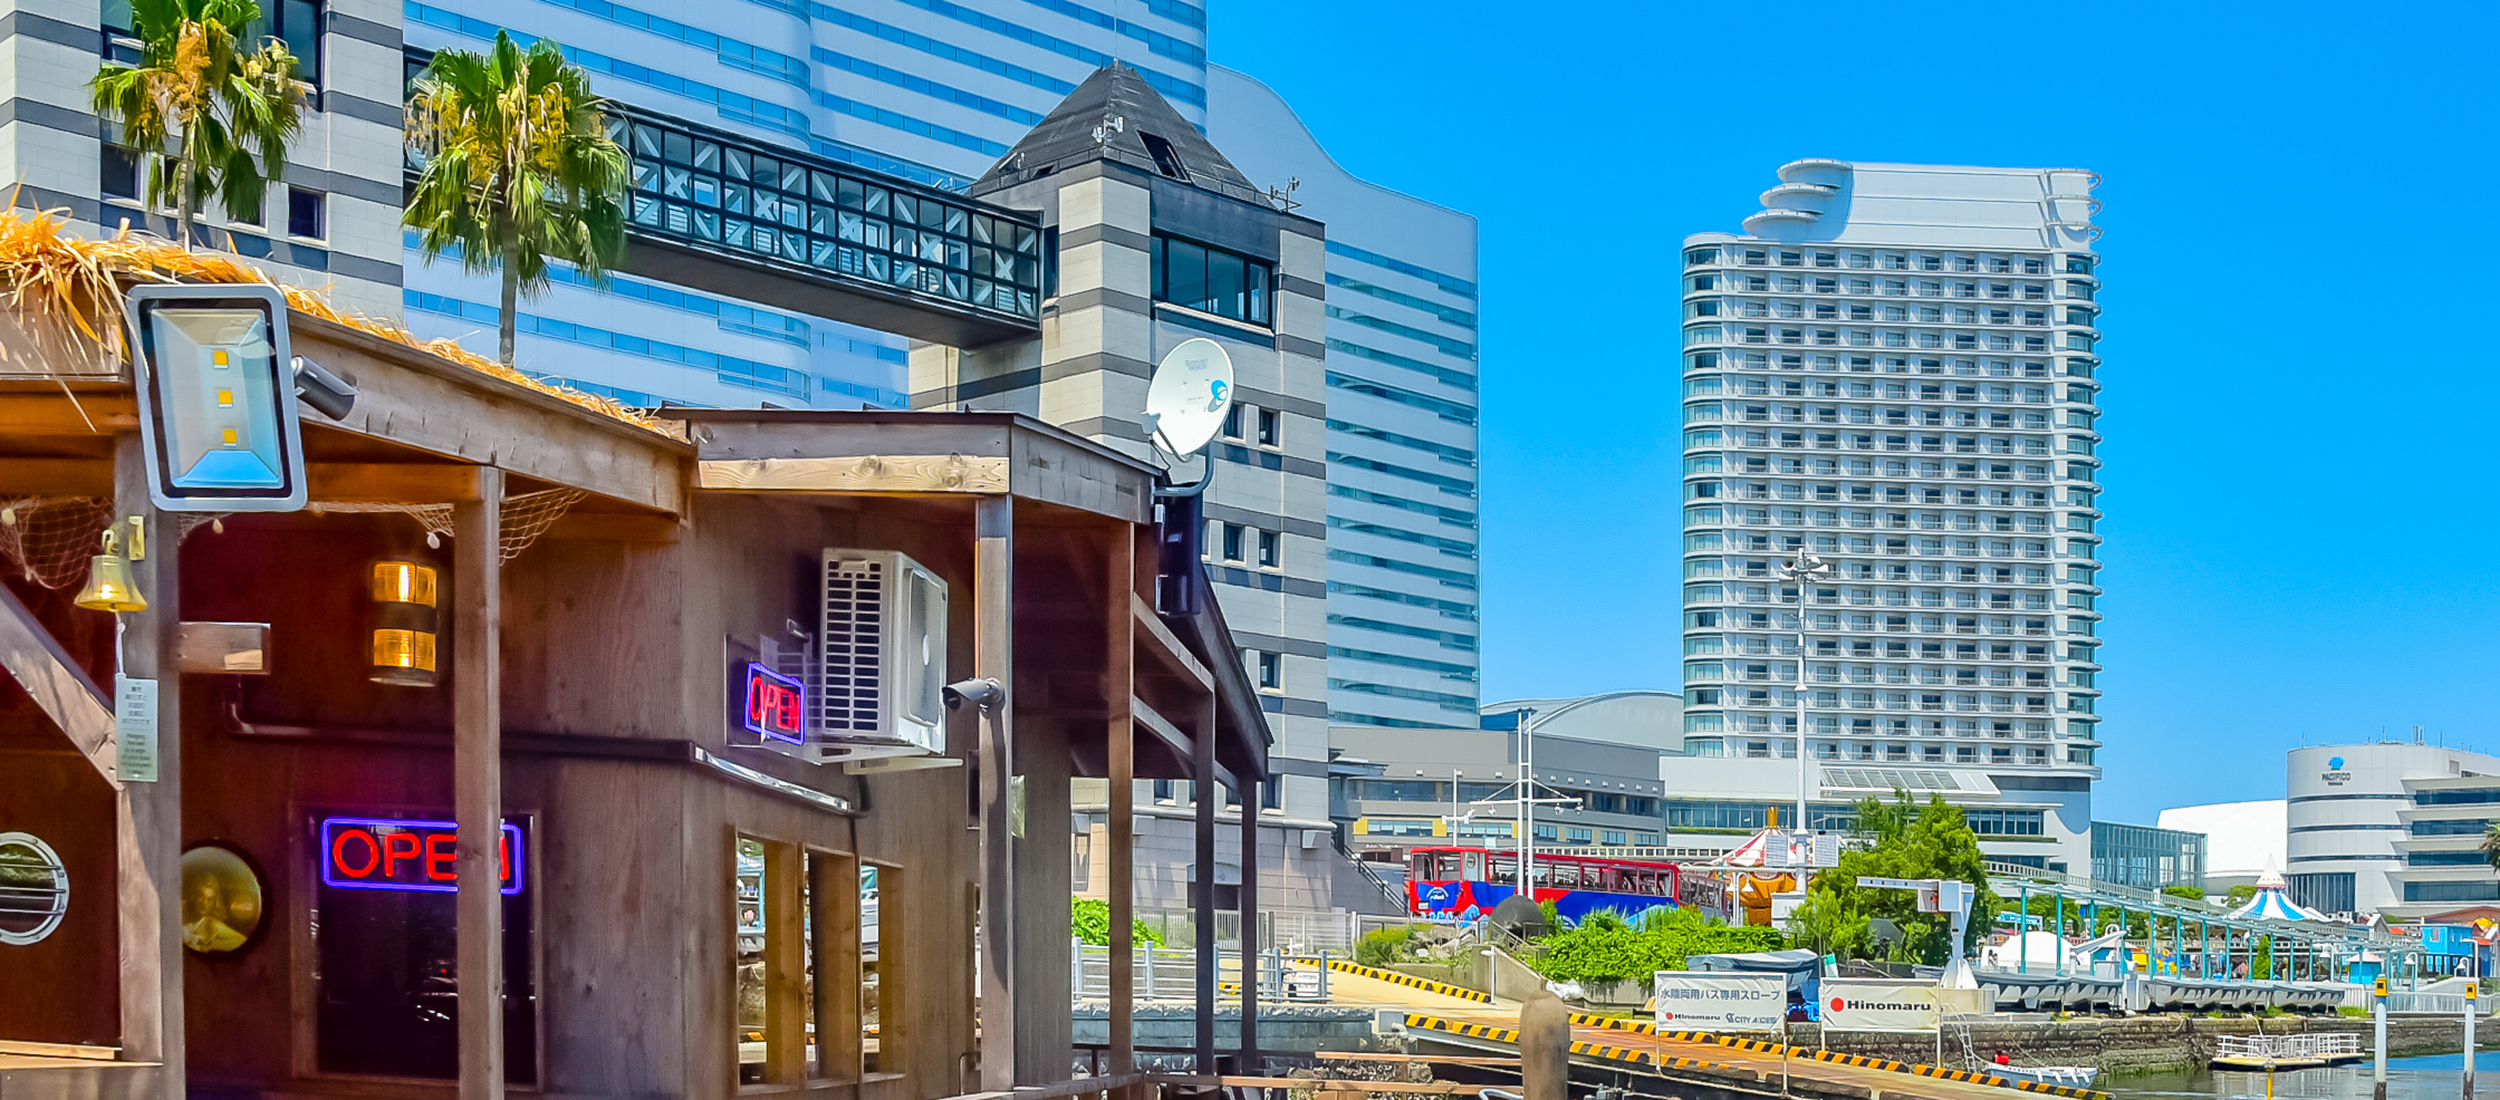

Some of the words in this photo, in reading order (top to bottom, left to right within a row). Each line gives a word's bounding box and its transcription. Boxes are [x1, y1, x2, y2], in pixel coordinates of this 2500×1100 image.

[750, 676, 800, 733] OPEN
[2321, 772, 2351, 781] PACIFICO
[333, 829, 510, 882] OPE
[1847, 1000, 1932, 1011] Hinomaru
[1674, 1013, 1721, 1021] Hinomaru
[1734, 1016, 1751, 1024] CITY
